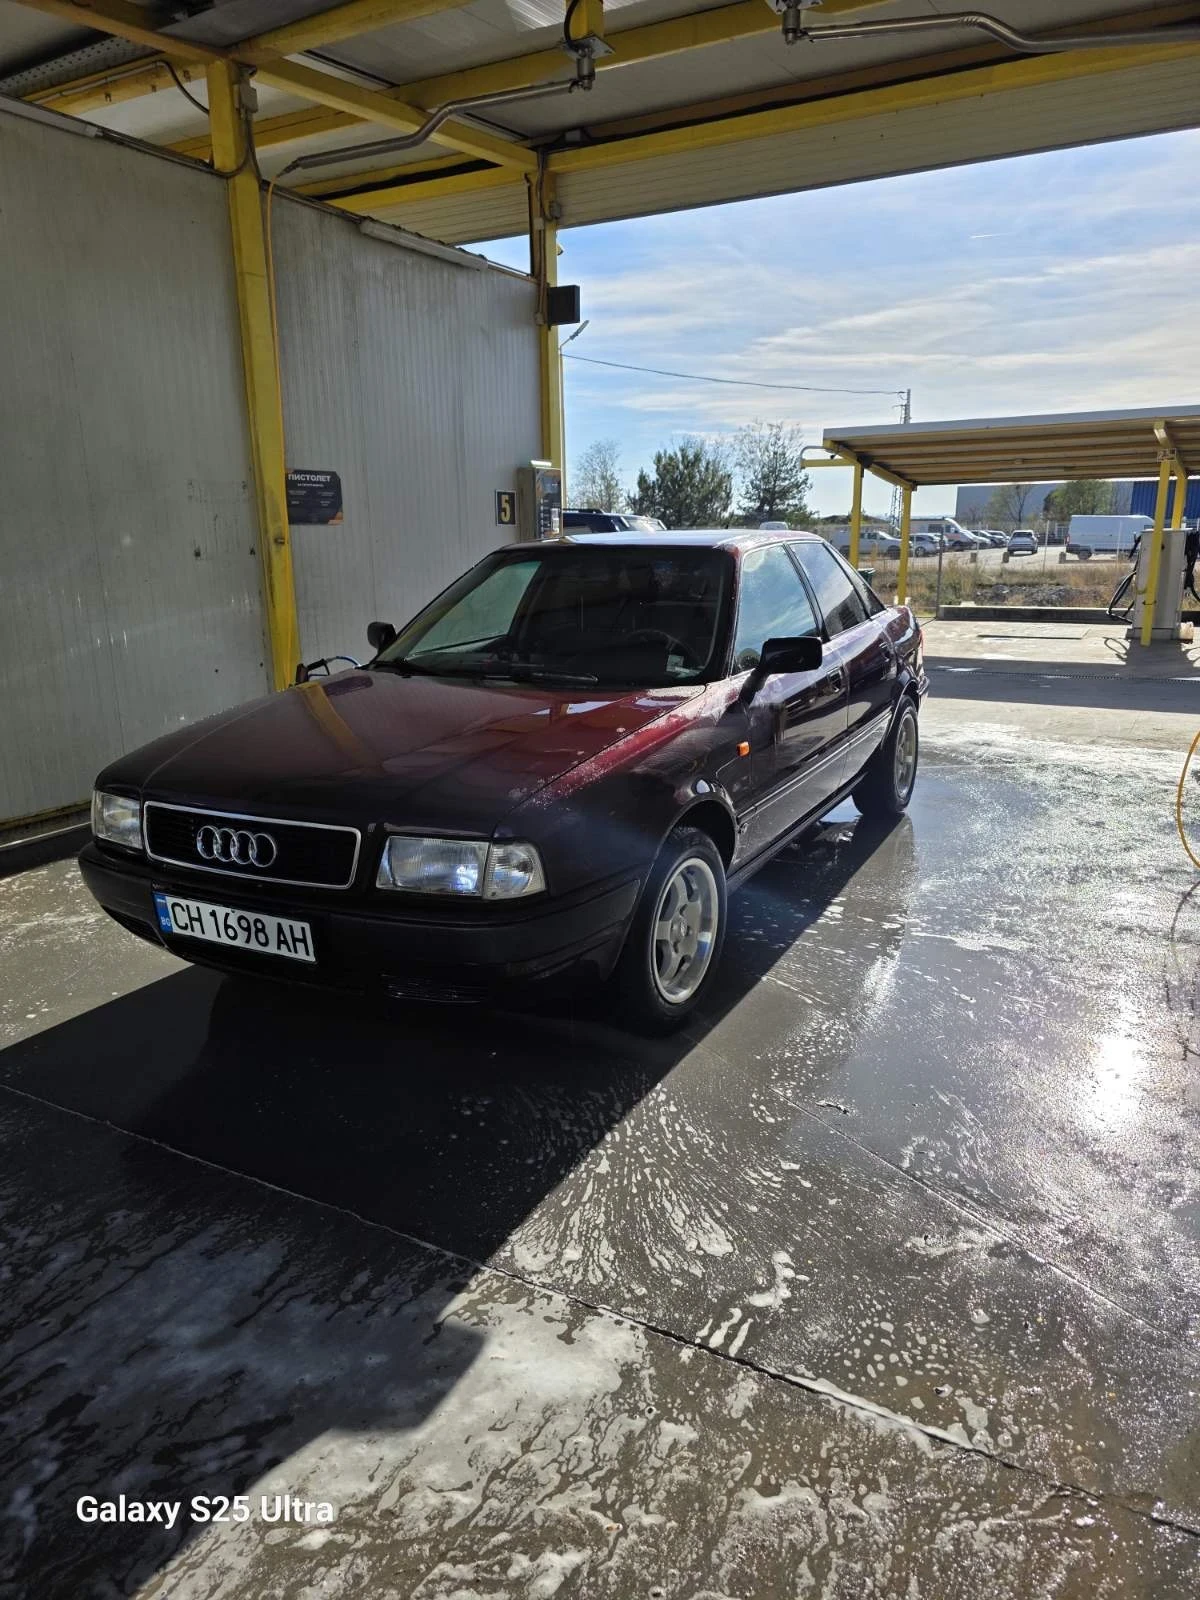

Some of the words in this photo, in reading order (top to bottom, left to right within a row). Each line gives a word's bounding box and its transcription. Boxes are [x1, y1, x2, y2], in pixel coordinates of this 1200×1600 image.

[288, 473, 331, 482] ПИСТОЛЕТ
[501, 494, 511, 522] 5
[161, 916, 171, 927] BG
[171, 902, 205, 935] CH
[210, 909, 270, 948] 1698
[276, 922, 310, 956] AH
